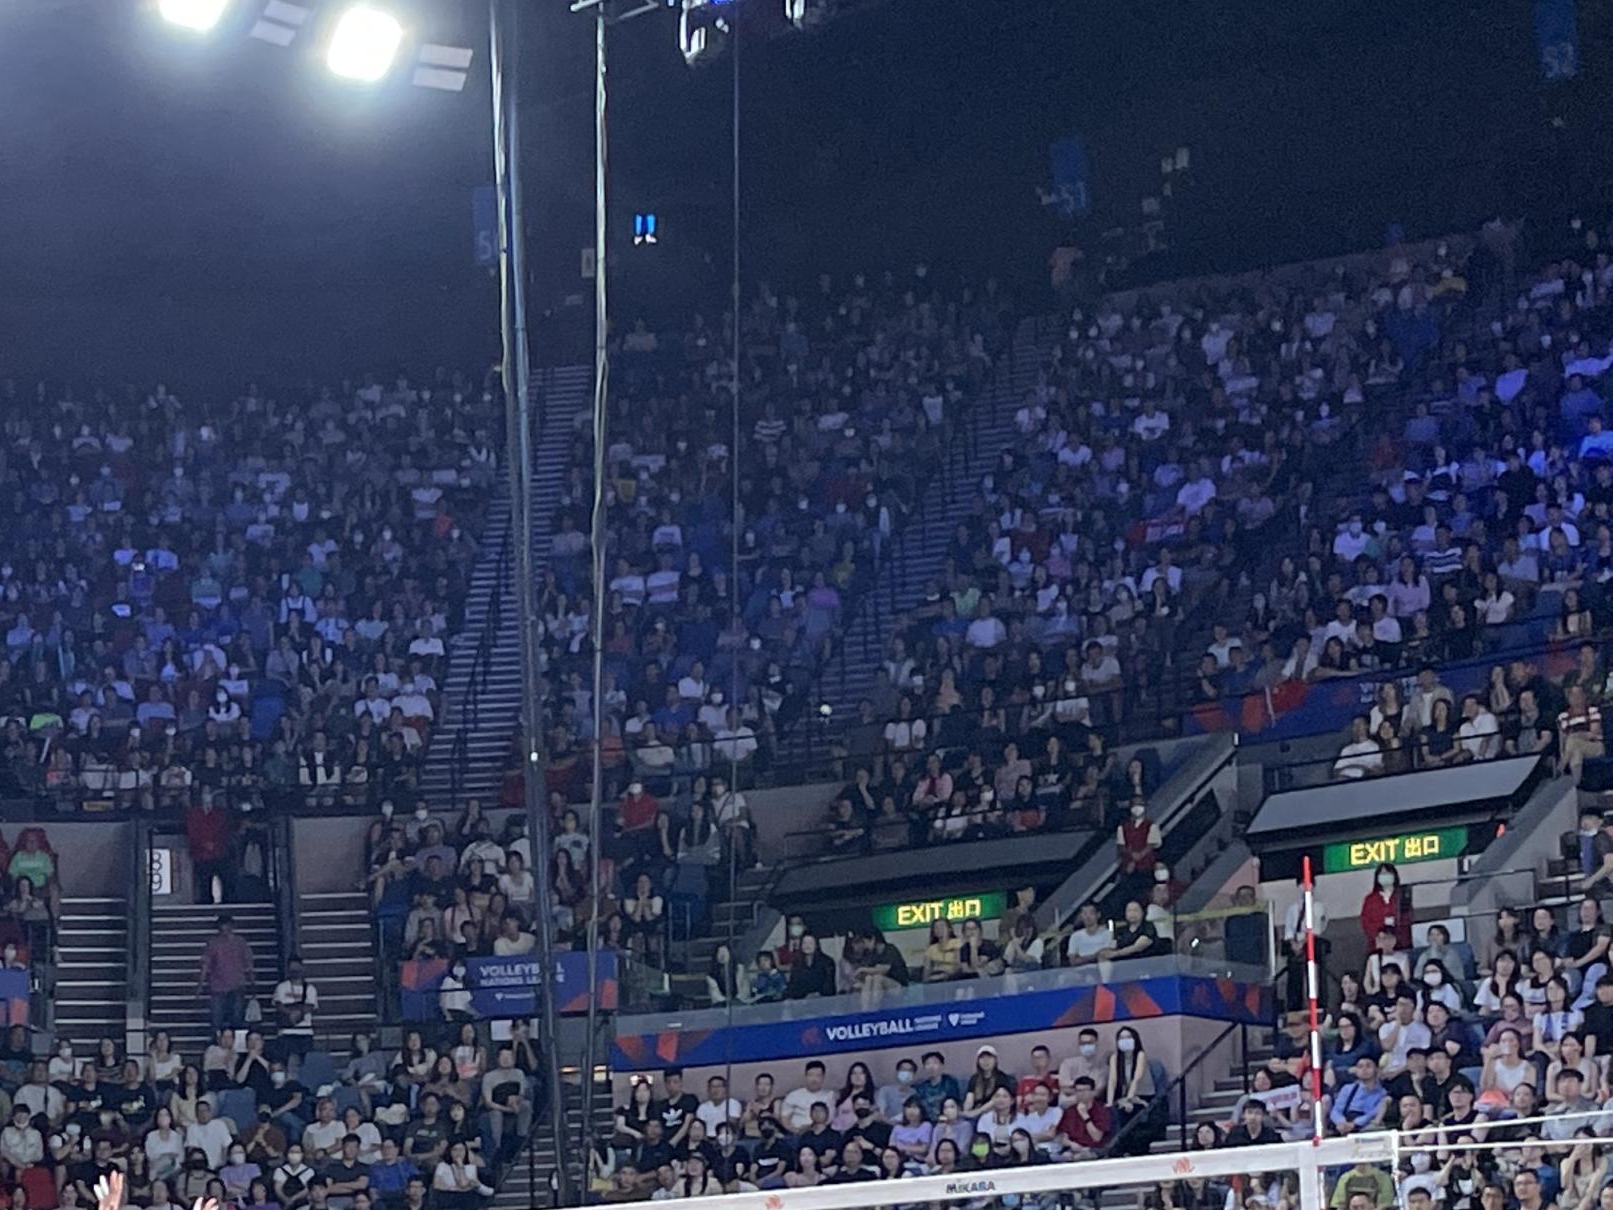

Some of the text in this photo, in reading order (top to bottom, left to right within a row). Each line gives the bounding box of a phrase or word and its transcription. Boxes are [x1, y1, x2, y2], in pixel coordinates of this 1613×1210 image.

[1350, 835, 1440, 866] EXIT 出口
[897, 899, 981, 926] EXIT 出口
[826, 1018, 914, 1041] VOLLEYBALL
